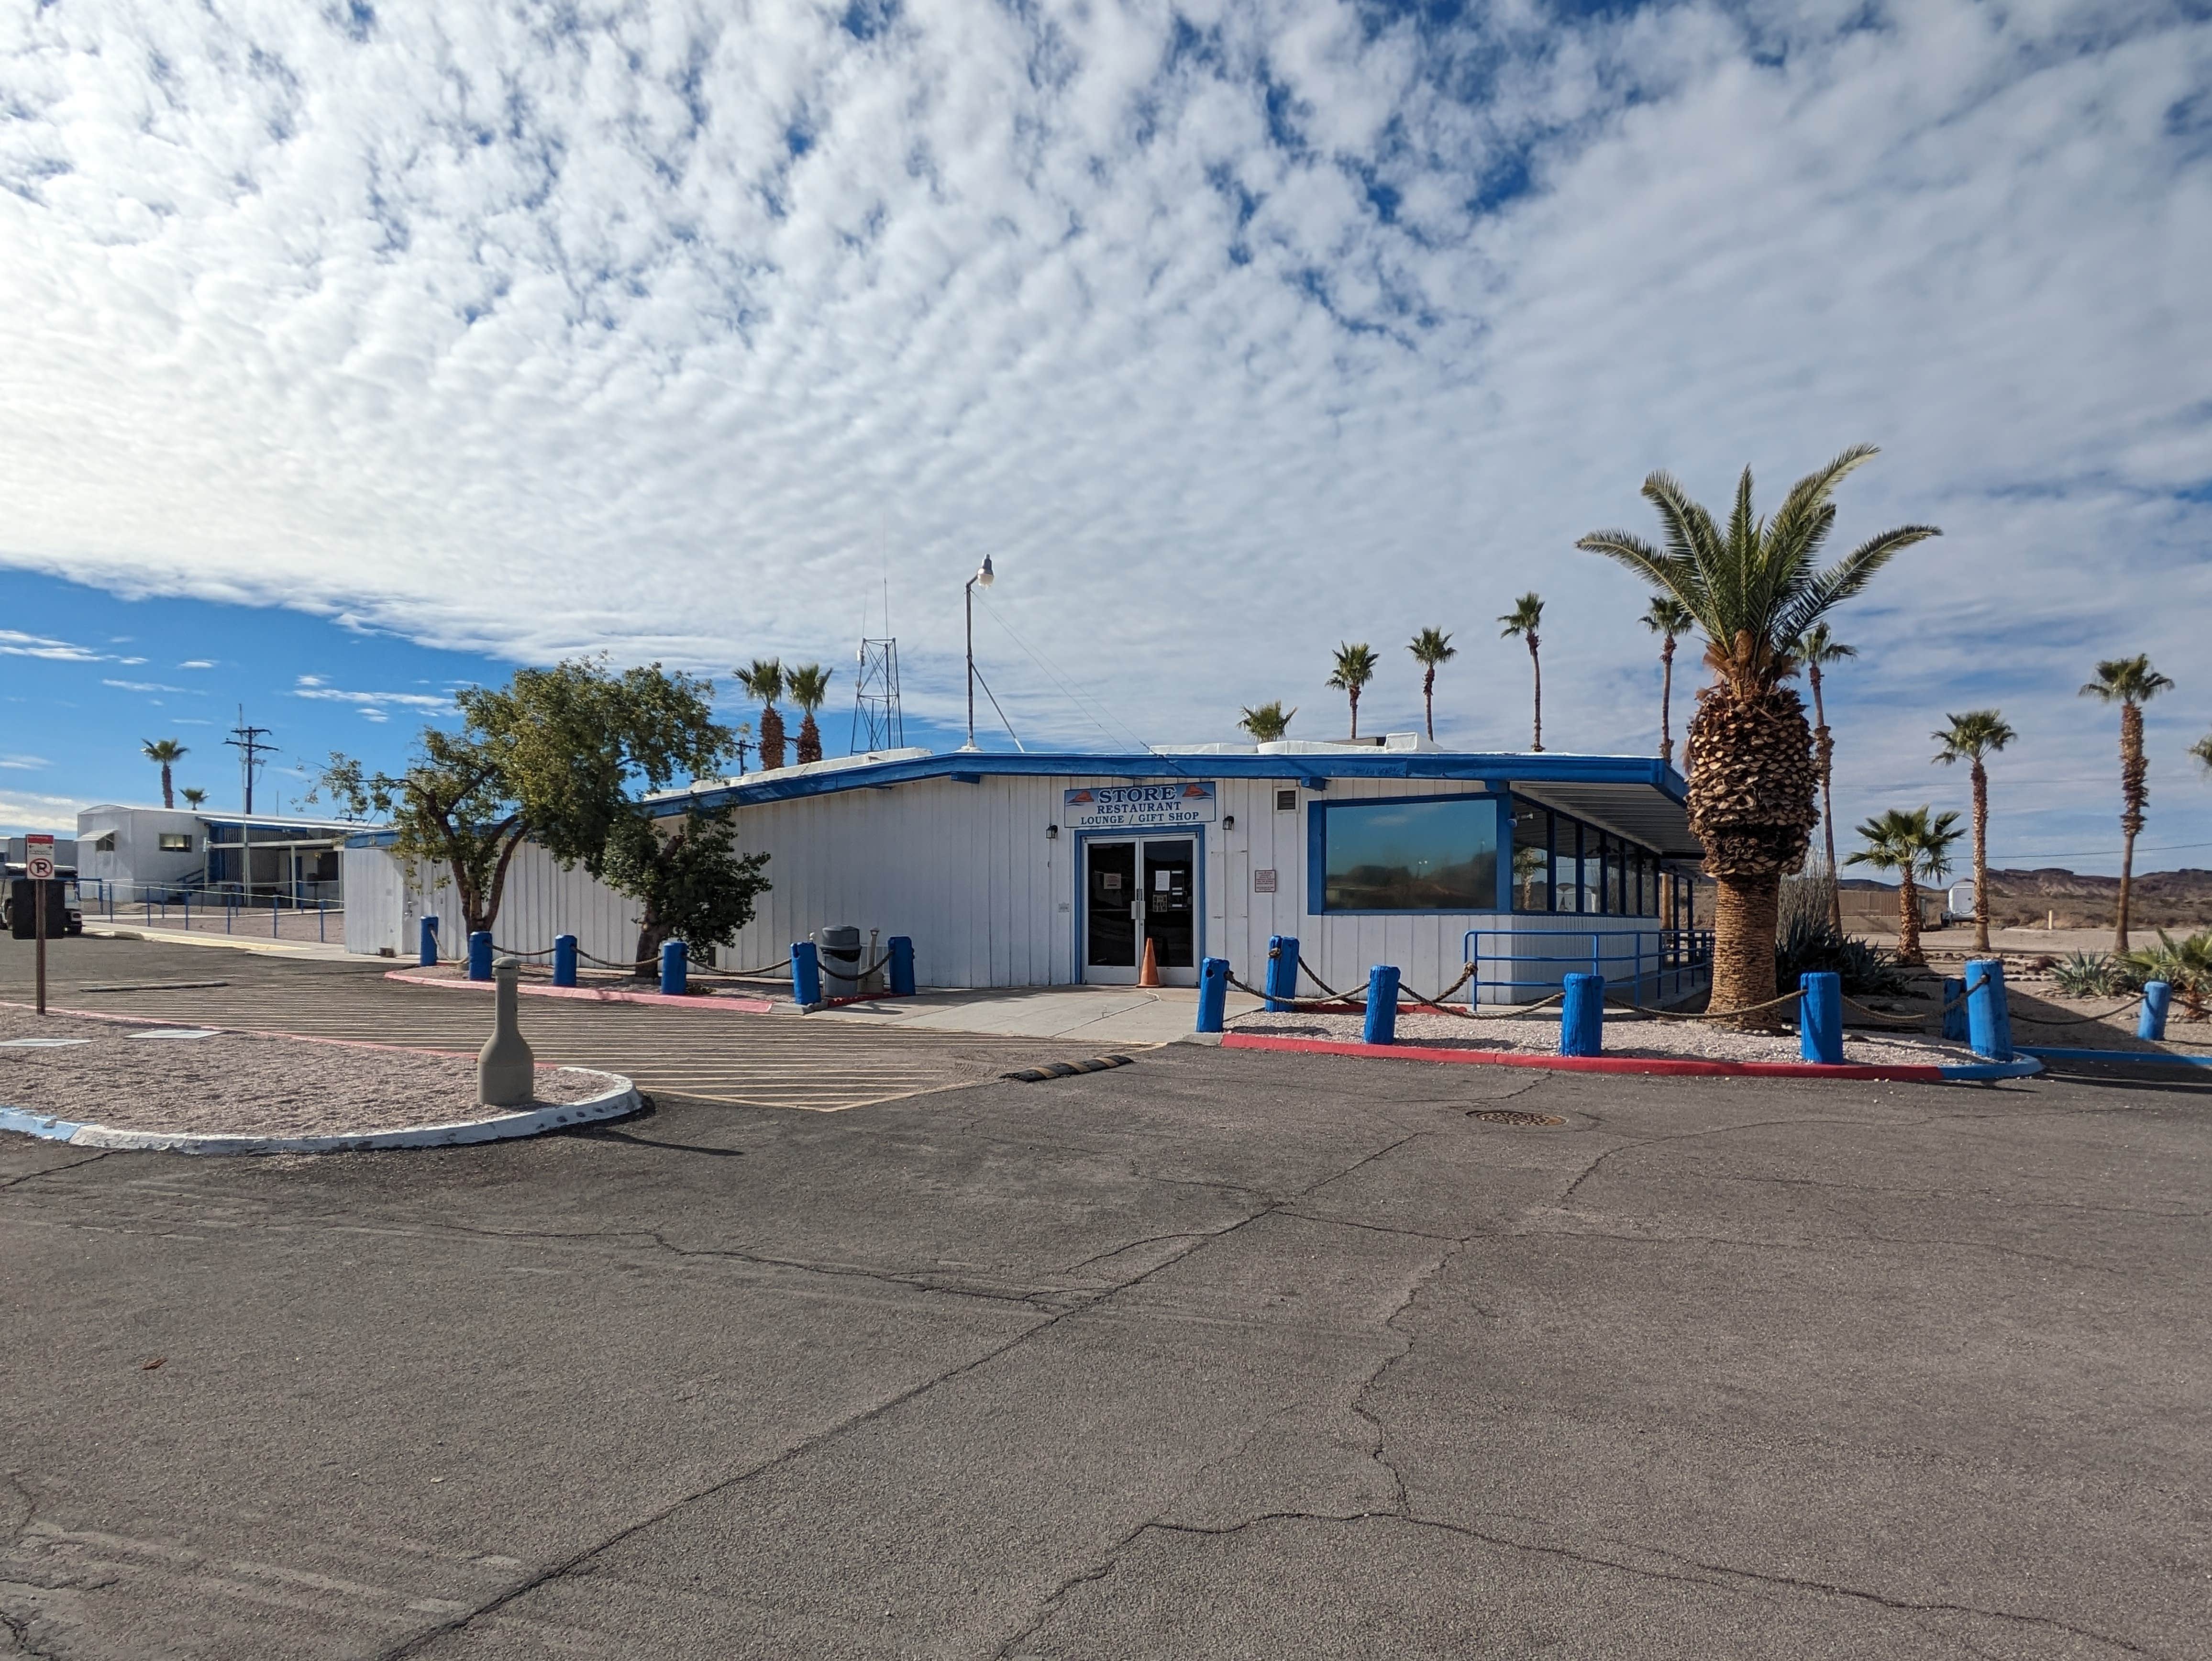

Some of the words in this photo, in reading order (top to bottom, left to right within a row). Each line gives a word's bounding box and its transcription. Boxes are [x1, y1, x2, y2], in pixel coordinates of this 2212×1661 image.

[1099, 786, 1176, 803] STORE
[1097, 801, 1182, 814] RESTAURANT
[1081, 815, 1124, 825] LOUNGE
[1129, 814, 1134, 824] /
[1138, 813, 1164, 823] GIFT
[1168, 812, 1199, 821] SHOP
